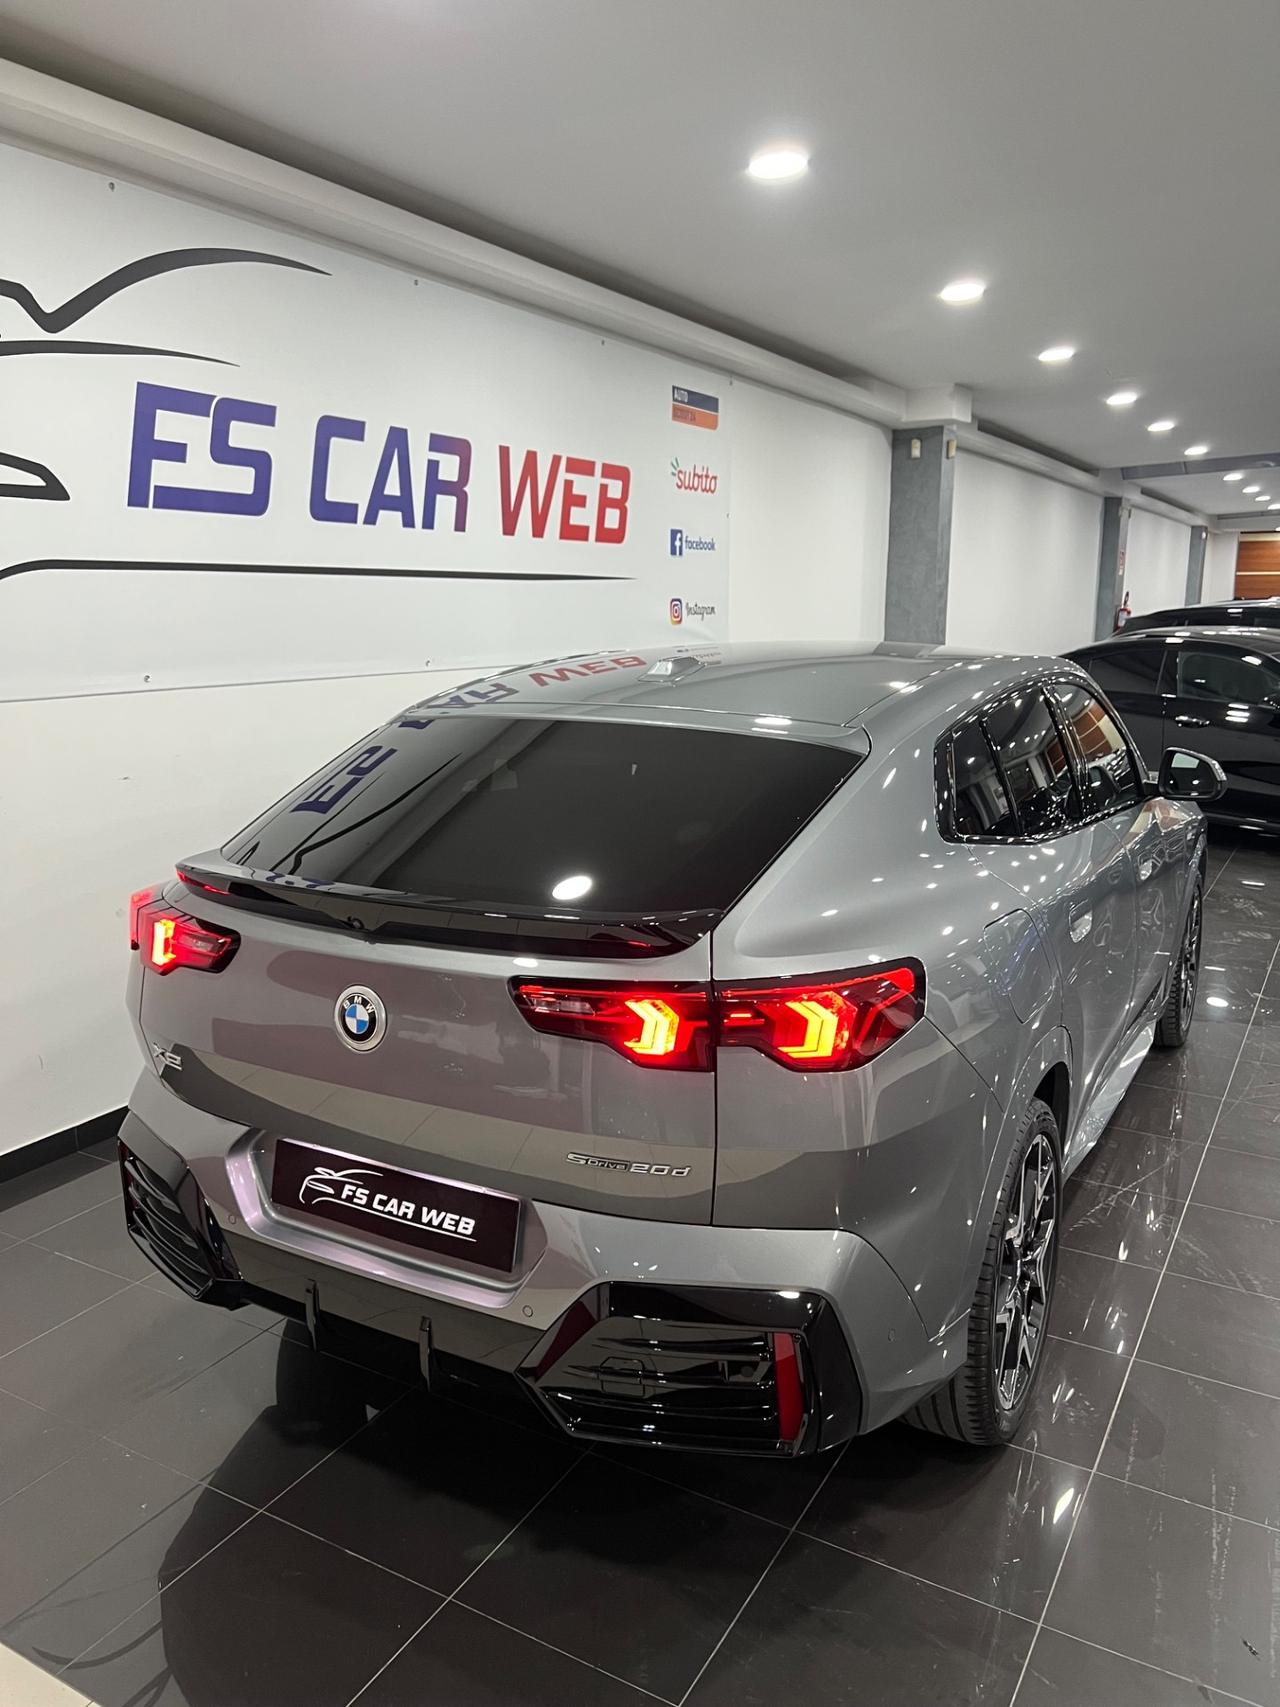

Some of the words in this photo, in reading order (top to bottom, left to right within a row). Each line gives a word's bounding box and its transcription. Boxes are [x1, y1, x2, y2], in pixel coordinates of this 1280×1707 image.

[127, 381, 277, 516] FS
[309, 415, 472, 532] CAR
[498, 444, 631, 544] WEB
[676, 464, 718, 494] subito
[685, 536, 716, 551] facebook
[343, 995, 375, 1013] BMW
[341, 1184, 370, 1203] FS
[372, 1193, 416, 1219] CAR
[421, 1209, 476, 1236] WEB
